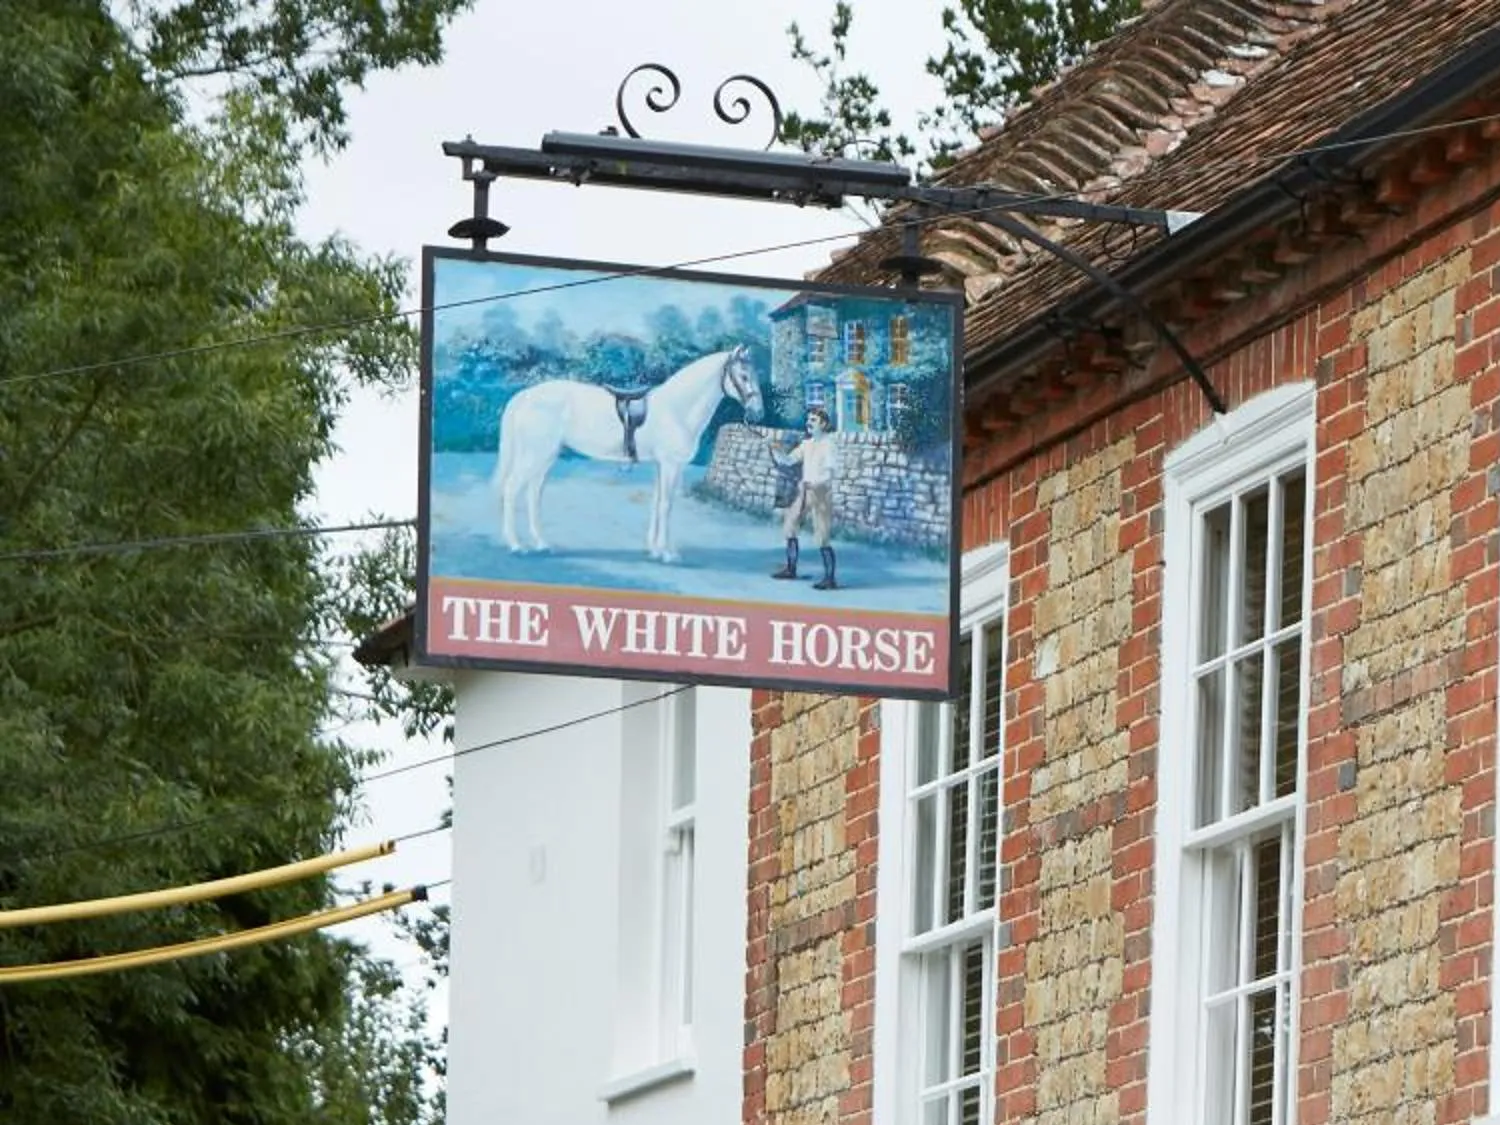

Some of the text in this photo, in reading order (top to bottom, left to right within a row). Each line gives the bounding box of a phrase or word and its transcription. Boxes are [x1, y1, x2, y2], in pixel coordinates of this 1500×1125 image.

[442, 595, 935, 674] THE WHITE HORSE
